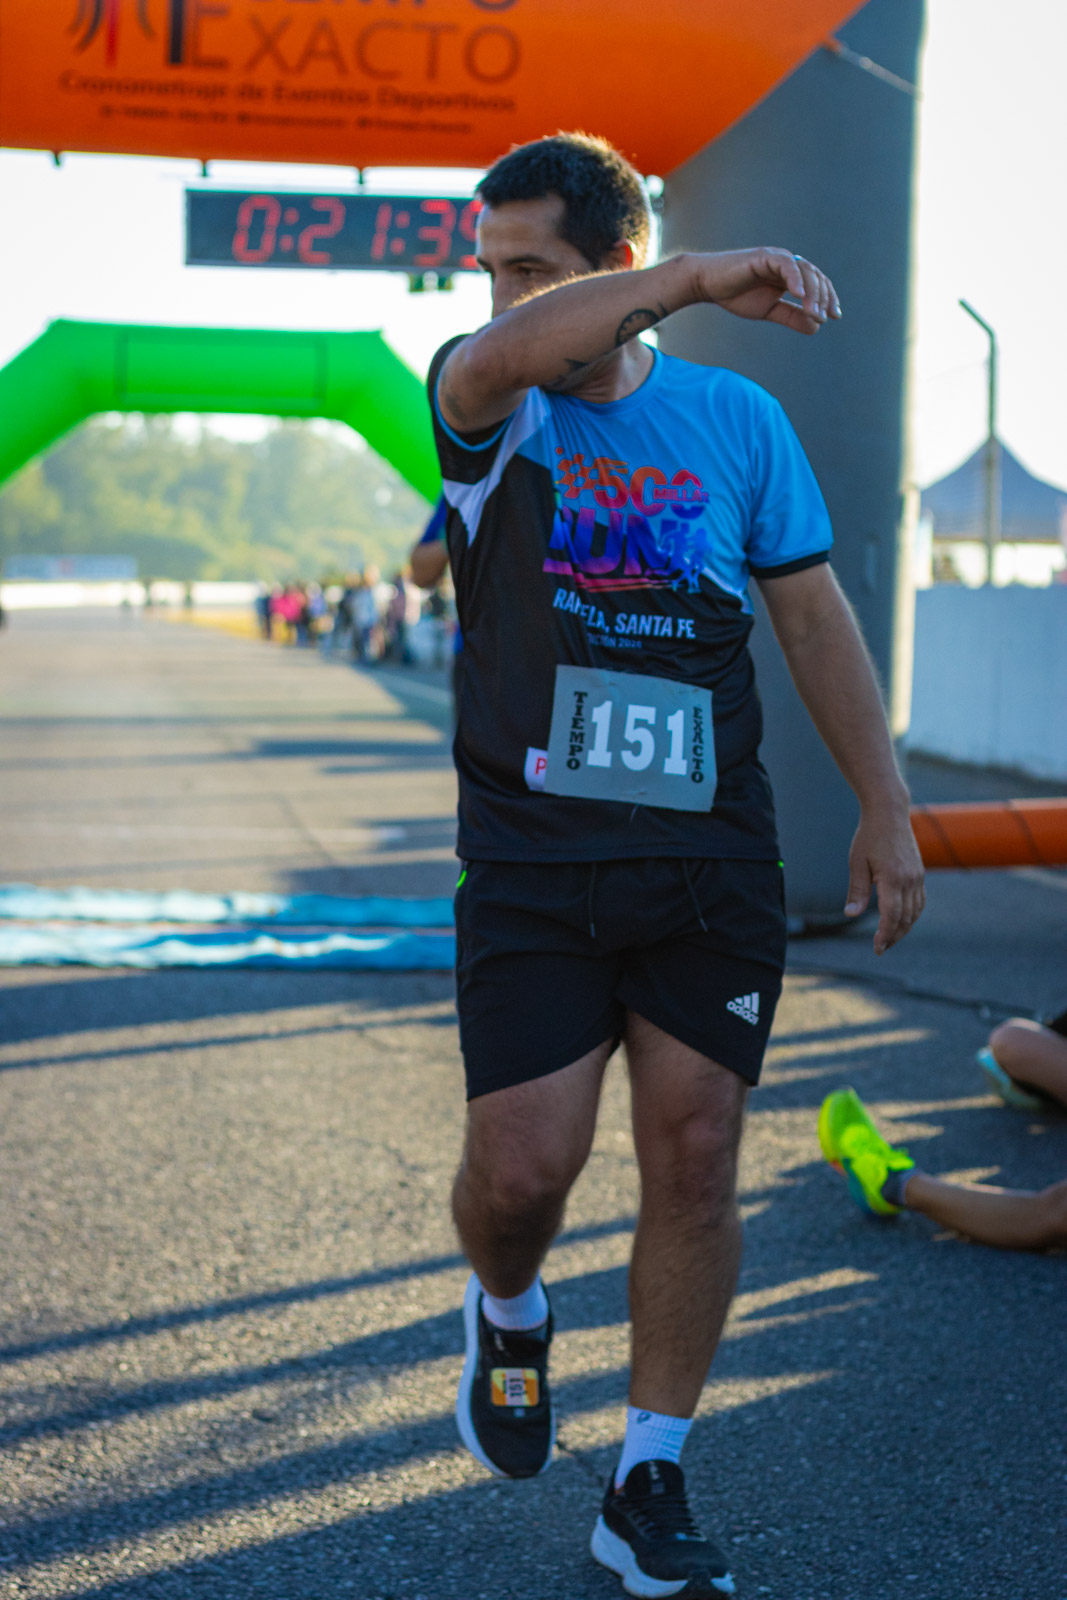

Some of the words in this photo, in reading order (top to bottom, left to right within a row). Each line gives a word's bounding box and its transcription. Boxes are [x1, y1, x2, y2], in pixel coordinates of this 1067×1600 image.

[192, 7, 521, 84] EXACTO
[614, 612, 673, 637] SANTA
[676, 618, 696, 639] FE
[566, 691, 588, 770] TIEMPO
[586, 700, 688, 776] 151
[691, 706, 705, 784] EXACTO
